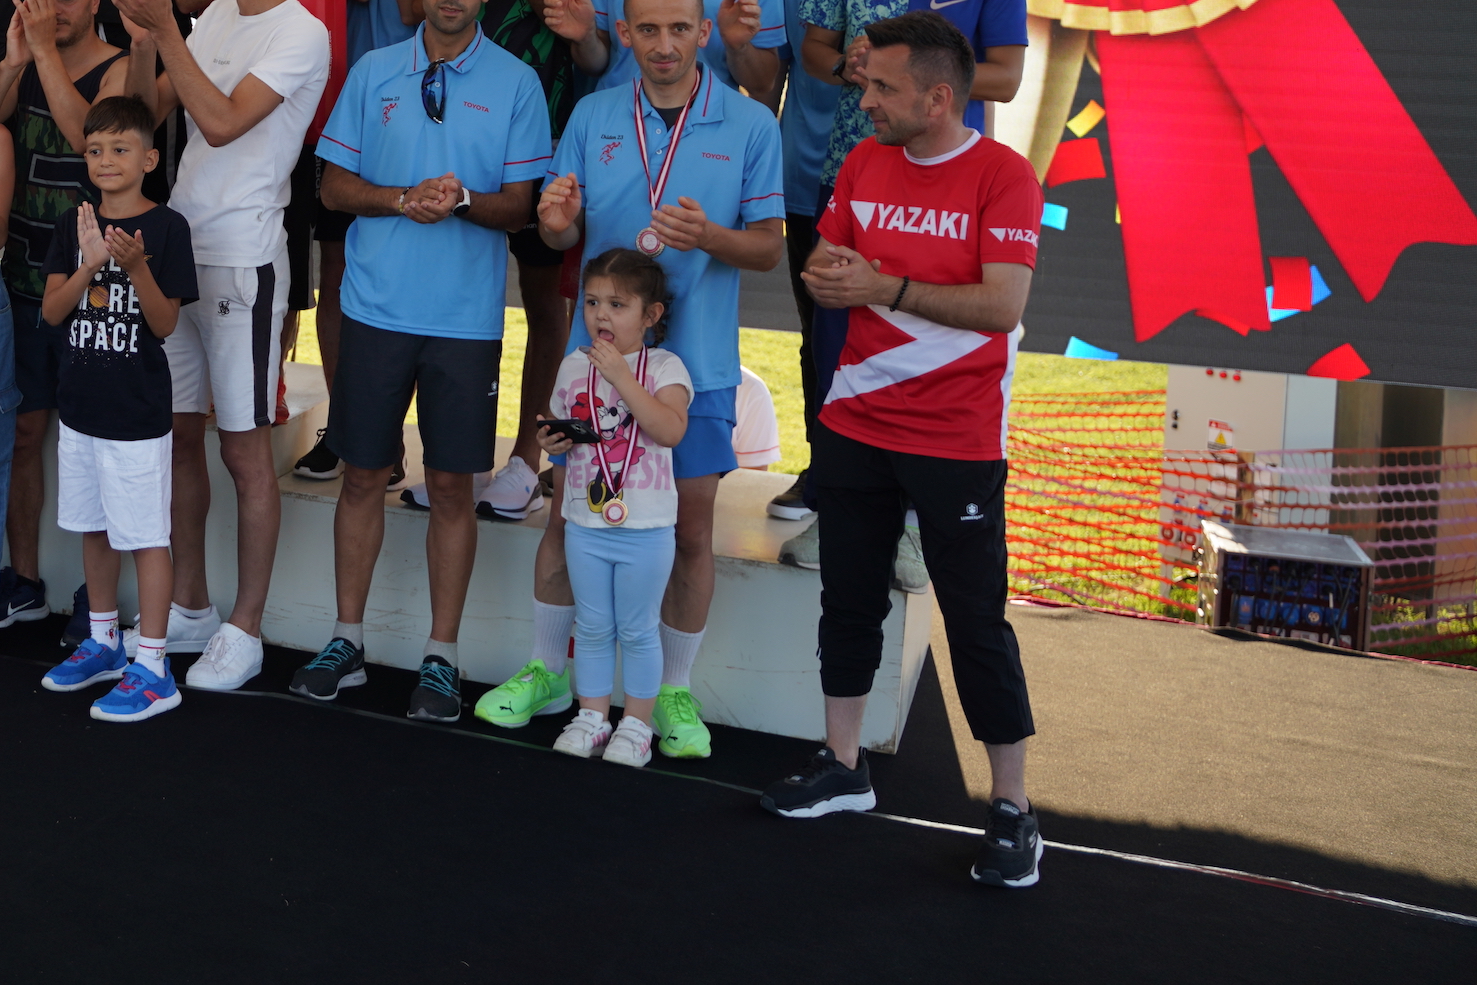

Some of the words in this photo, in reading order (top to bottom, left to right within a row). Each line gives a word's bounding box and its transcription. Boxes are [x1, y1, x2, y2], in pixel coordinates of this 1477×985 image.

[463, 100, 490, 113] TOYOTA
[701, 151, 731, 162] TOYOTA
[877, 202, 970, 241] YAZAKI
[69, 318, 139, 353] SPACE
[567, 452, 672, 491] REFESH
